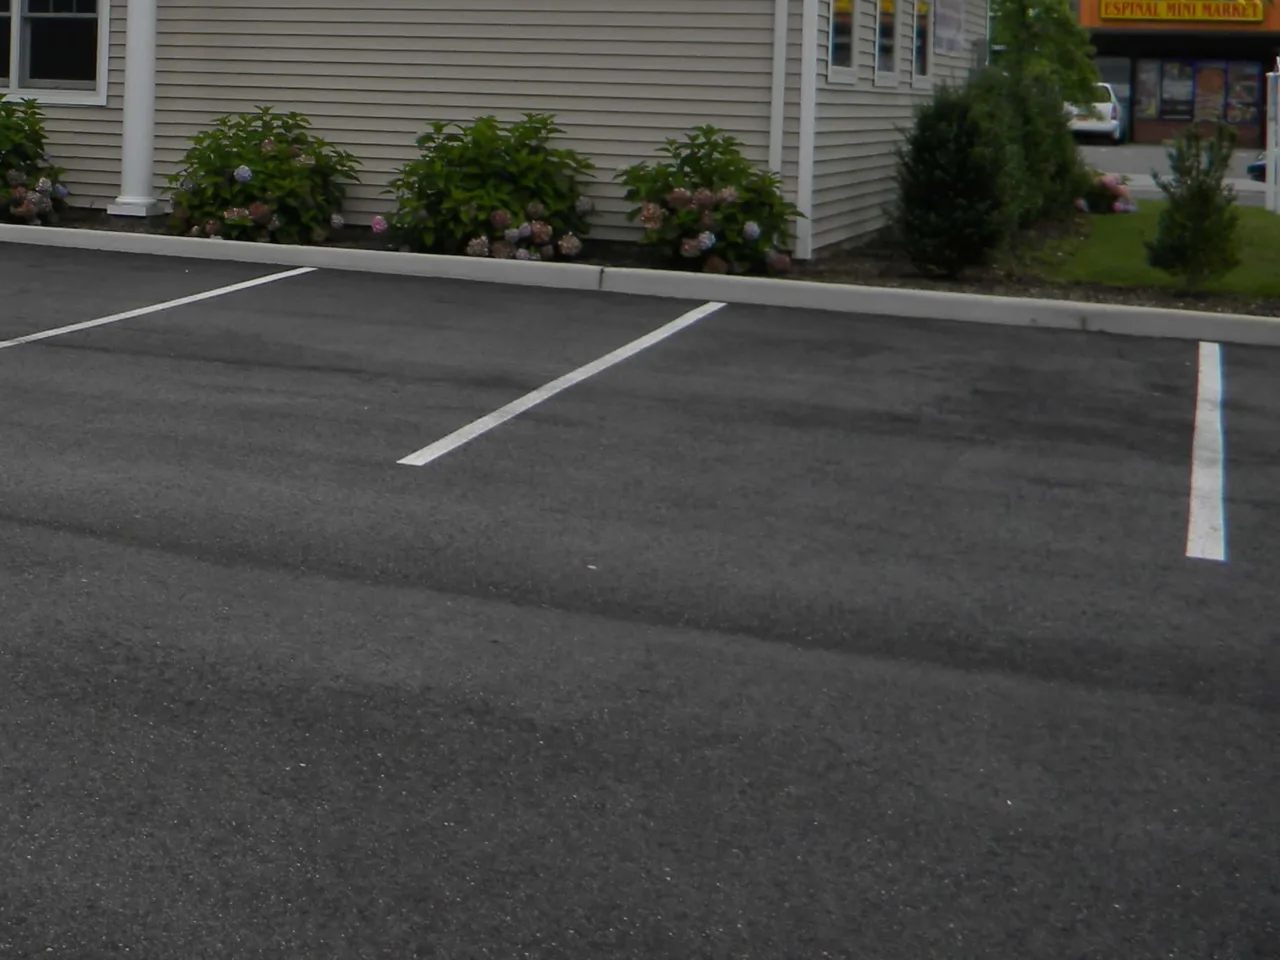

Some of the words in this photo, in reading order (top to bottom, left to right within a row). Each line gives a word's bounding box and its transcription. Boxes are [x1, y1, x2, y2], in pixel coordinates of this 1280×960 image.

[1104, 1, 1159, 16] ESPINAL
[1166, 2, 1196, 17] MINI
[1202, 3, 1259, 18] MARKET
